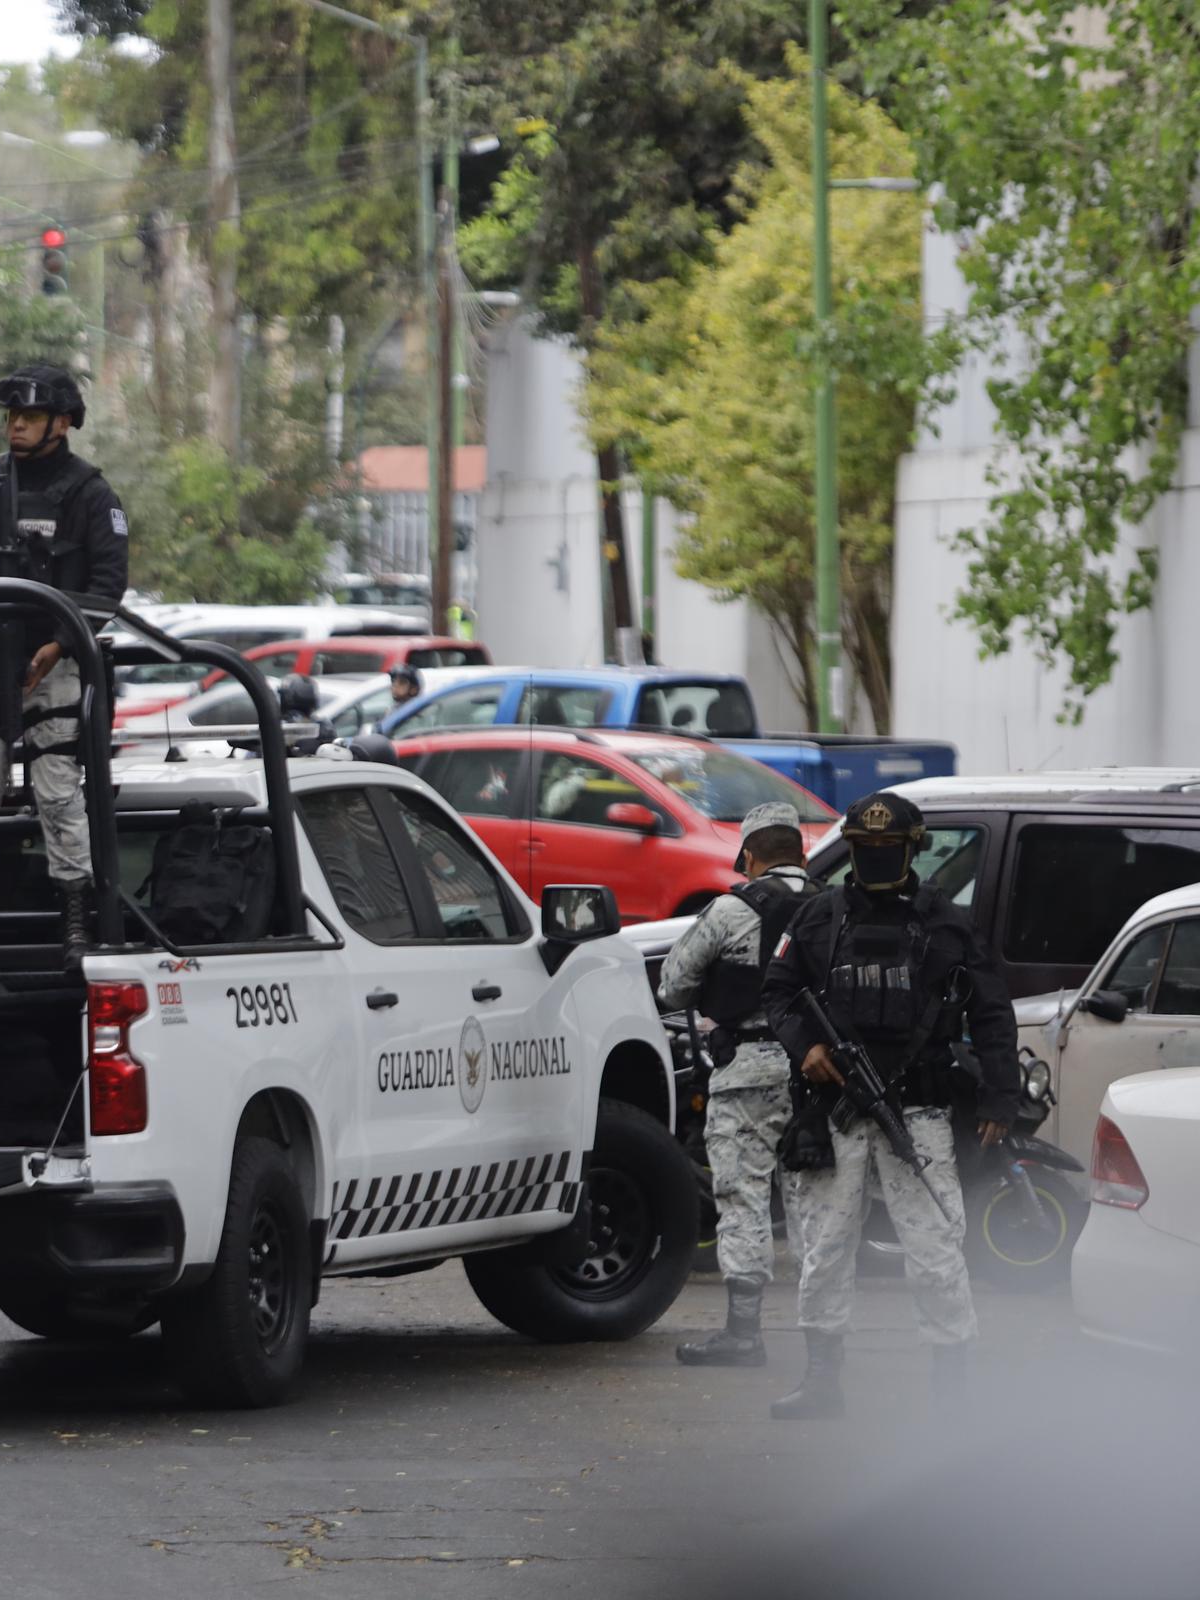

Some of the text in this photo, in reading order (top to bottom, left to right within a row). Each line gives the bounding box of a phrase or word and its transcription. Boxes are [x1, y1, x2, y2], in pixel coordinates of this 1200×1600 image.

[226, 982, 298, 1029] 29981
[377, 1036, 571, 1092] GUARDIA NACIONAL
